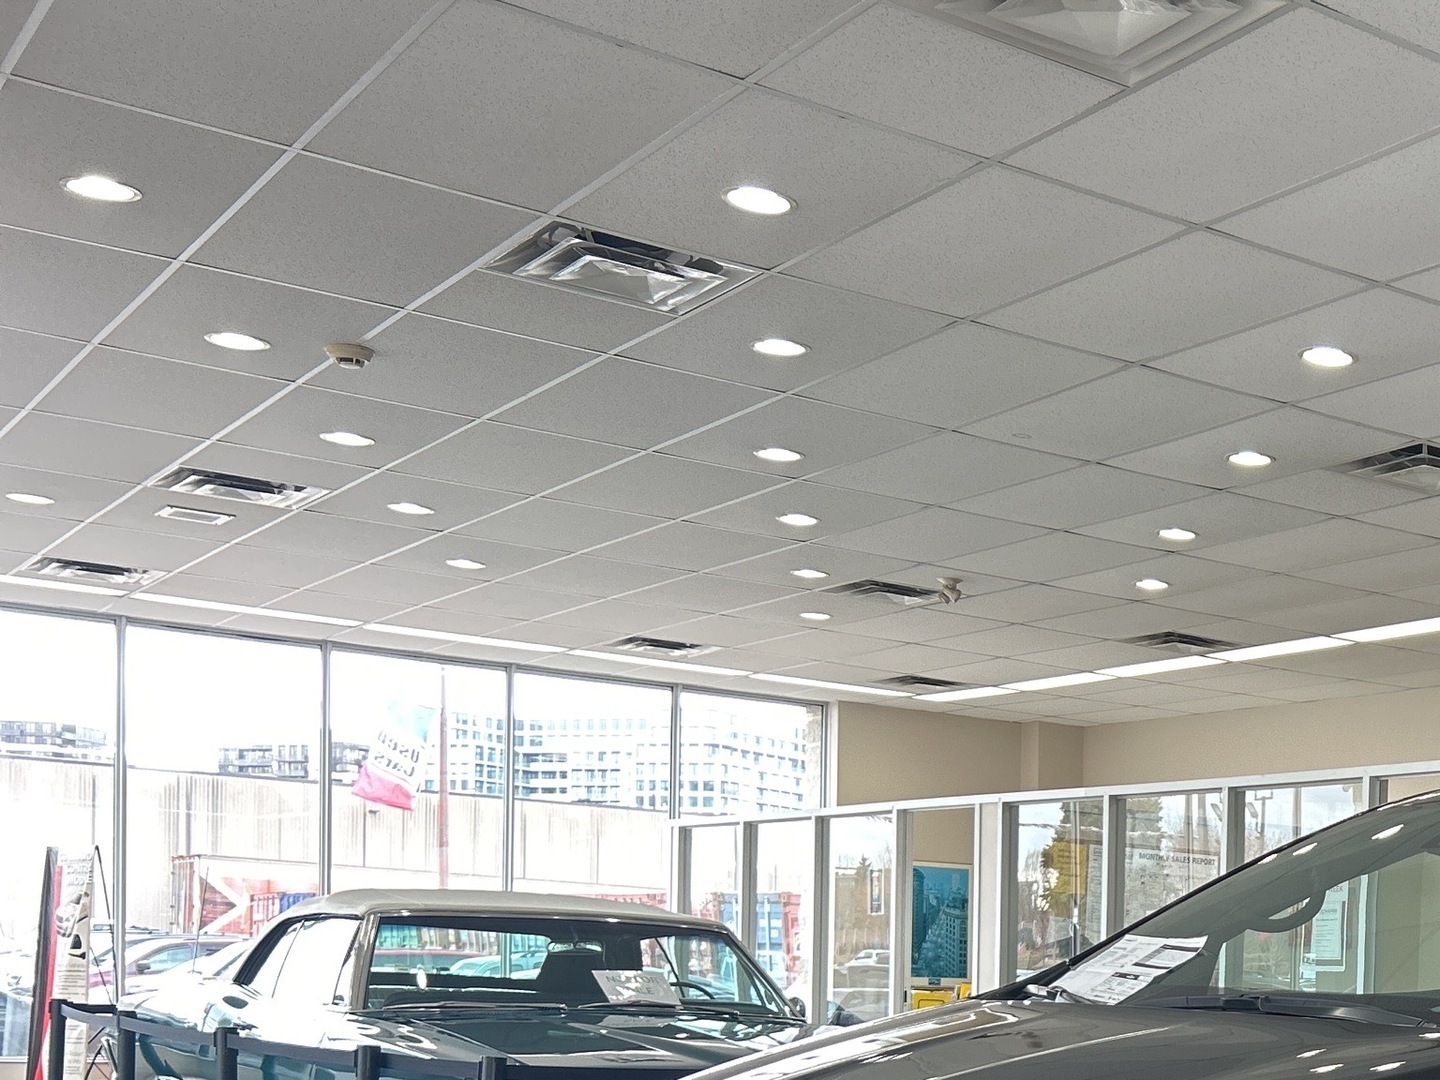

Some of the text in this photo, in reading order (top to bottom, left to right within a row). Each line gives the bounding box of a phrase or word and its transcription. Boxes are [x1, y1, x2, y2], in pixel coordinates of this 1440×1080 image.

[1138, 852, 1170, 862] MONTHLY
[1172, 855, 1191, 864] SALES
[1192, 856, 1216, 866] REPORT
